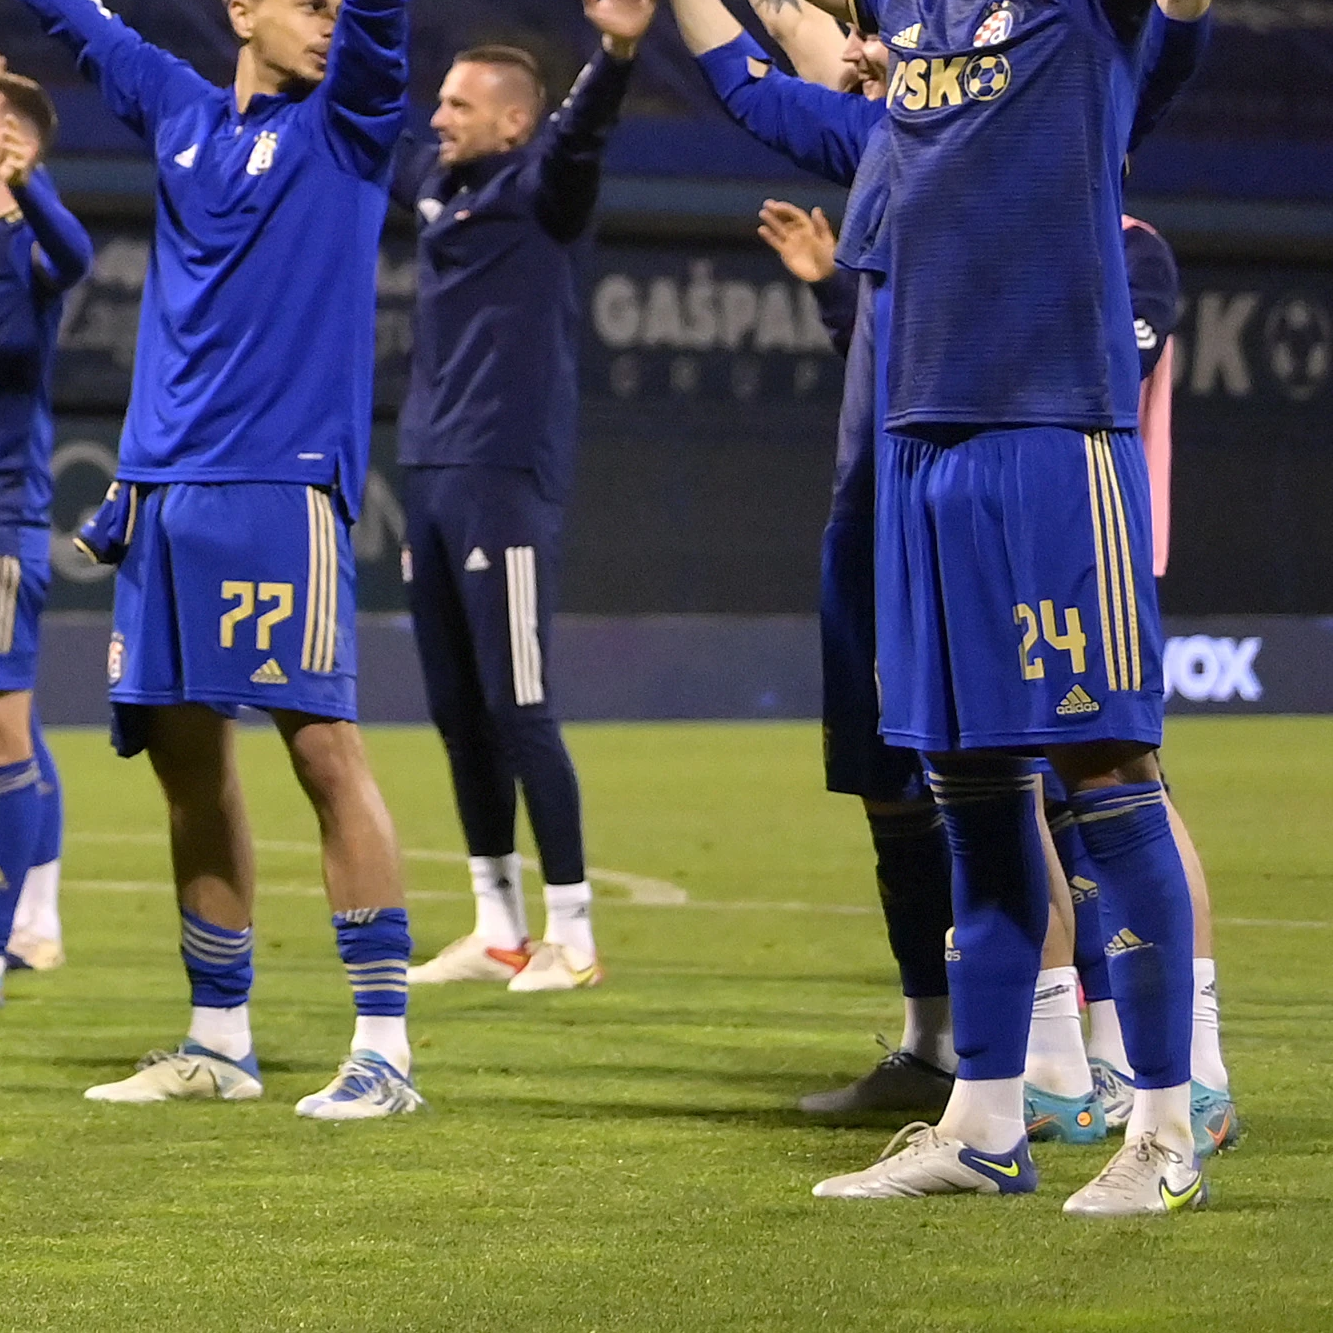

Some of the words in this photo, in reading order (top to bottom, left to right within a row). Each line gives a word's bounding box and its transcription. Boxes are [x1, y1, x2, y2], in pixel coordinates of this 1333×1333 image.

[219, 580, 294, 650] 77
[1012, 599, 1087, 680] 24
[1055, 702, 1100, 715] adidas
